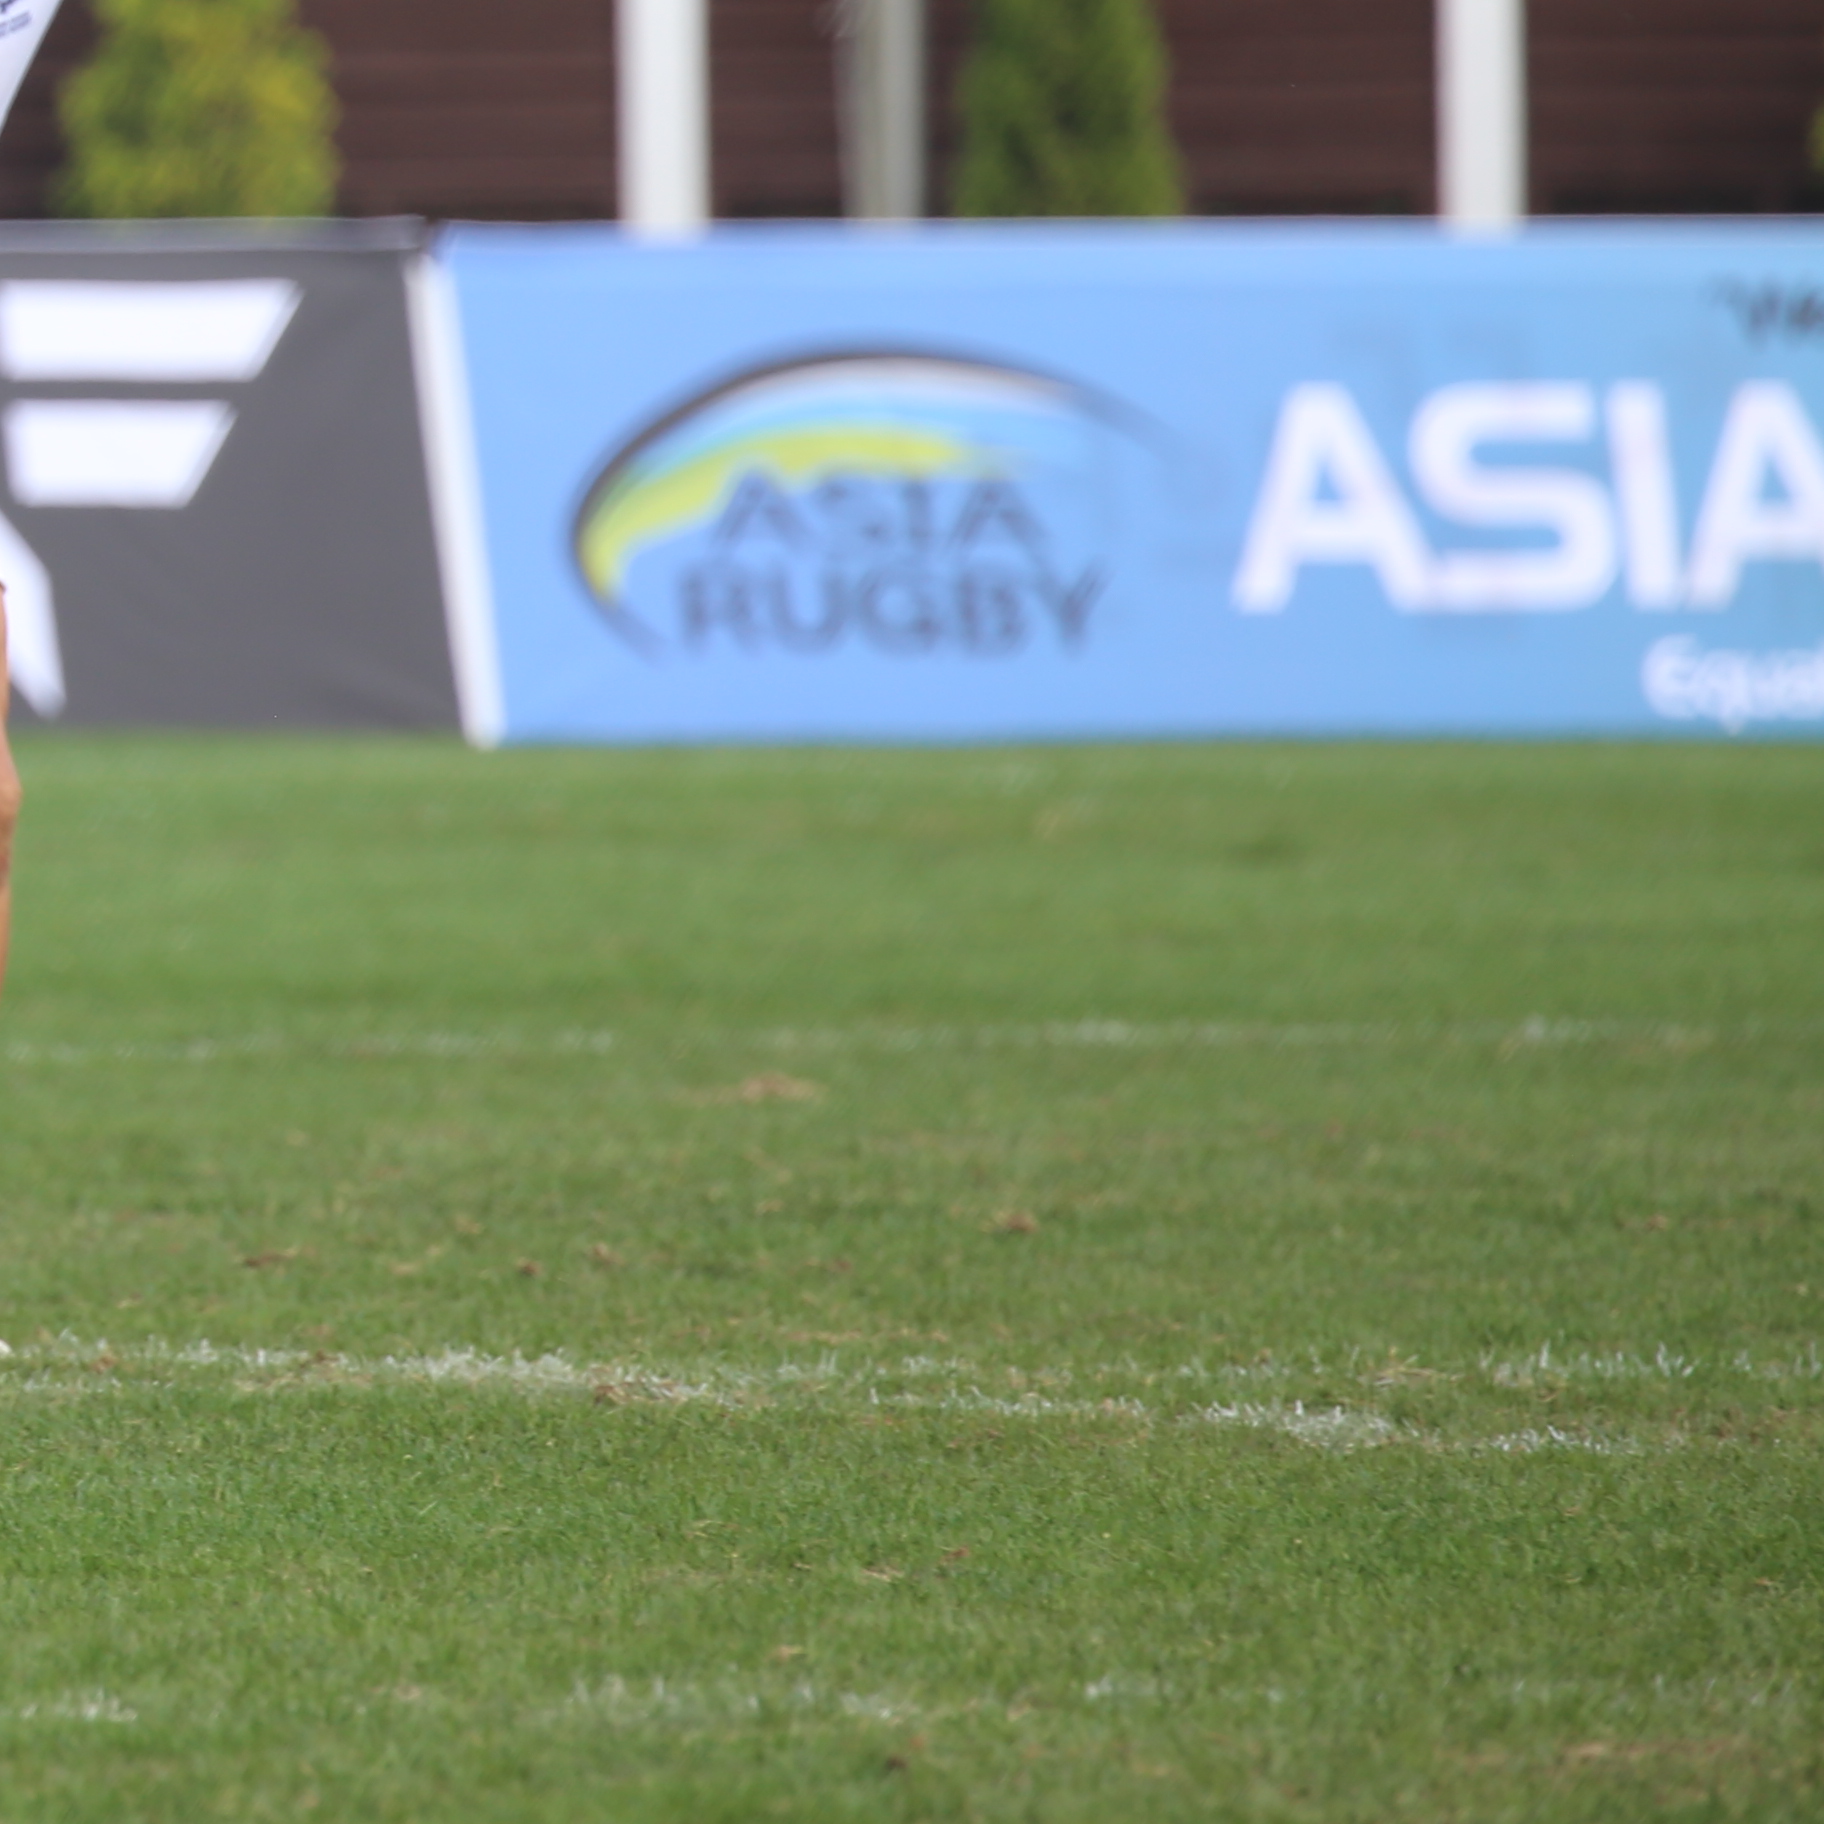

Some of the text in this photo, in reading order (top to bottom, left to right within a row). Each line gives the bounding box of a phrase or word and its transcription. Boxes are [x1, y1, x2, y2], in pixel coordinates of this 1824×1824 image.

[708, 464, 1052, 556] ASIA
[1232, 378, 1824, 616] ASIA
[677, 556, 1116, 662] RUGBY
